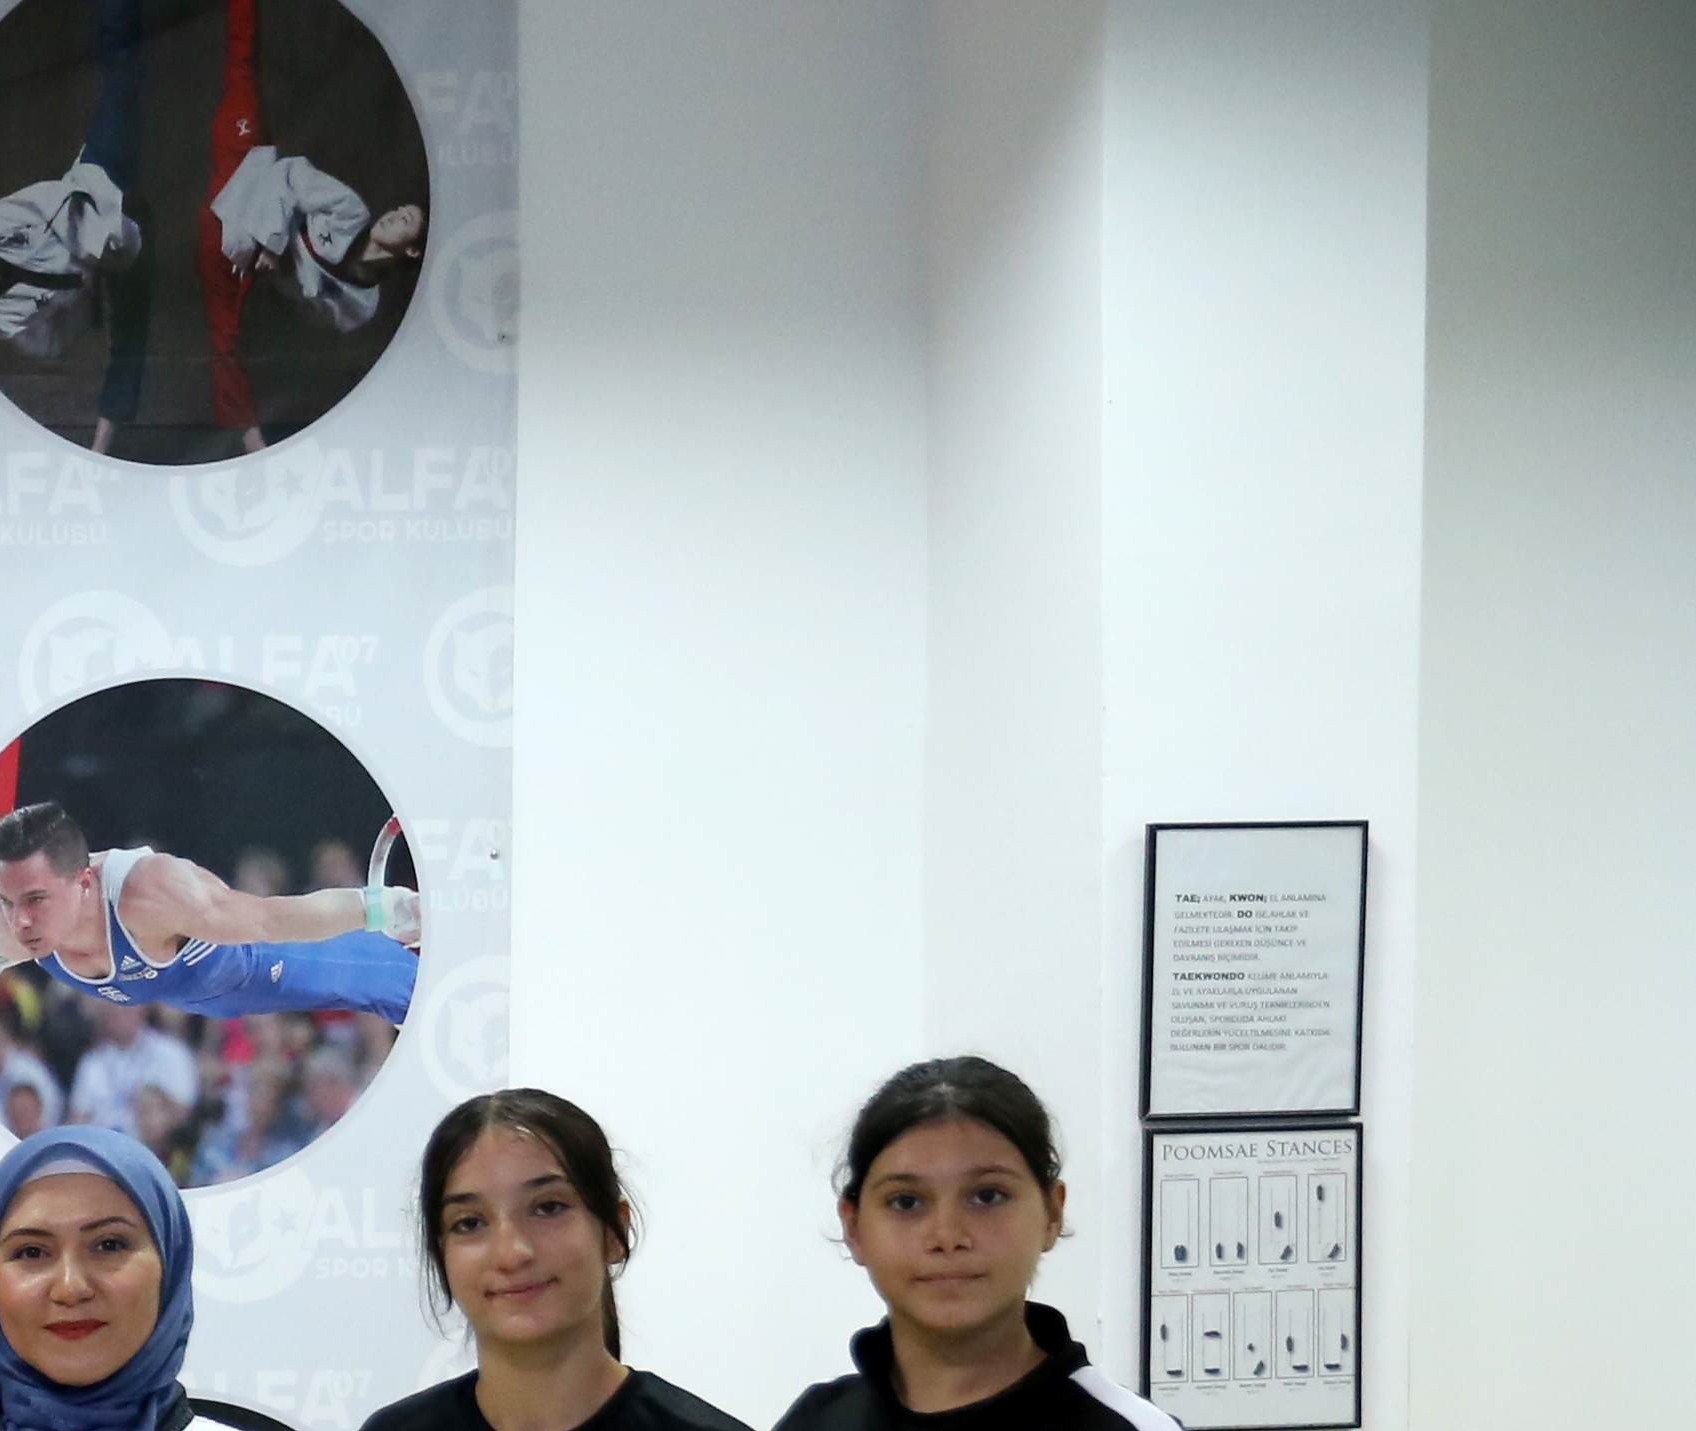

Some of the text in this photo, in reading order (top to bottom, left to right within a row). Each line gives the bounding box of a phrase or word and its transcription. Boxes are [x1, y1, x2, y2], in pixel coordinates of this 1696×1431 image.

[323, 521, 395, 544] SPOR
[1237, 910, 1253, 919] DO
[1172, 972, 1246, 981] TAEKWONDO
[1162, 1142, 1258, 1162] POOMSAE
[1265, 1138, 1353, 1158] STANCES
[314, 1257, 389, 1280] SPOR
